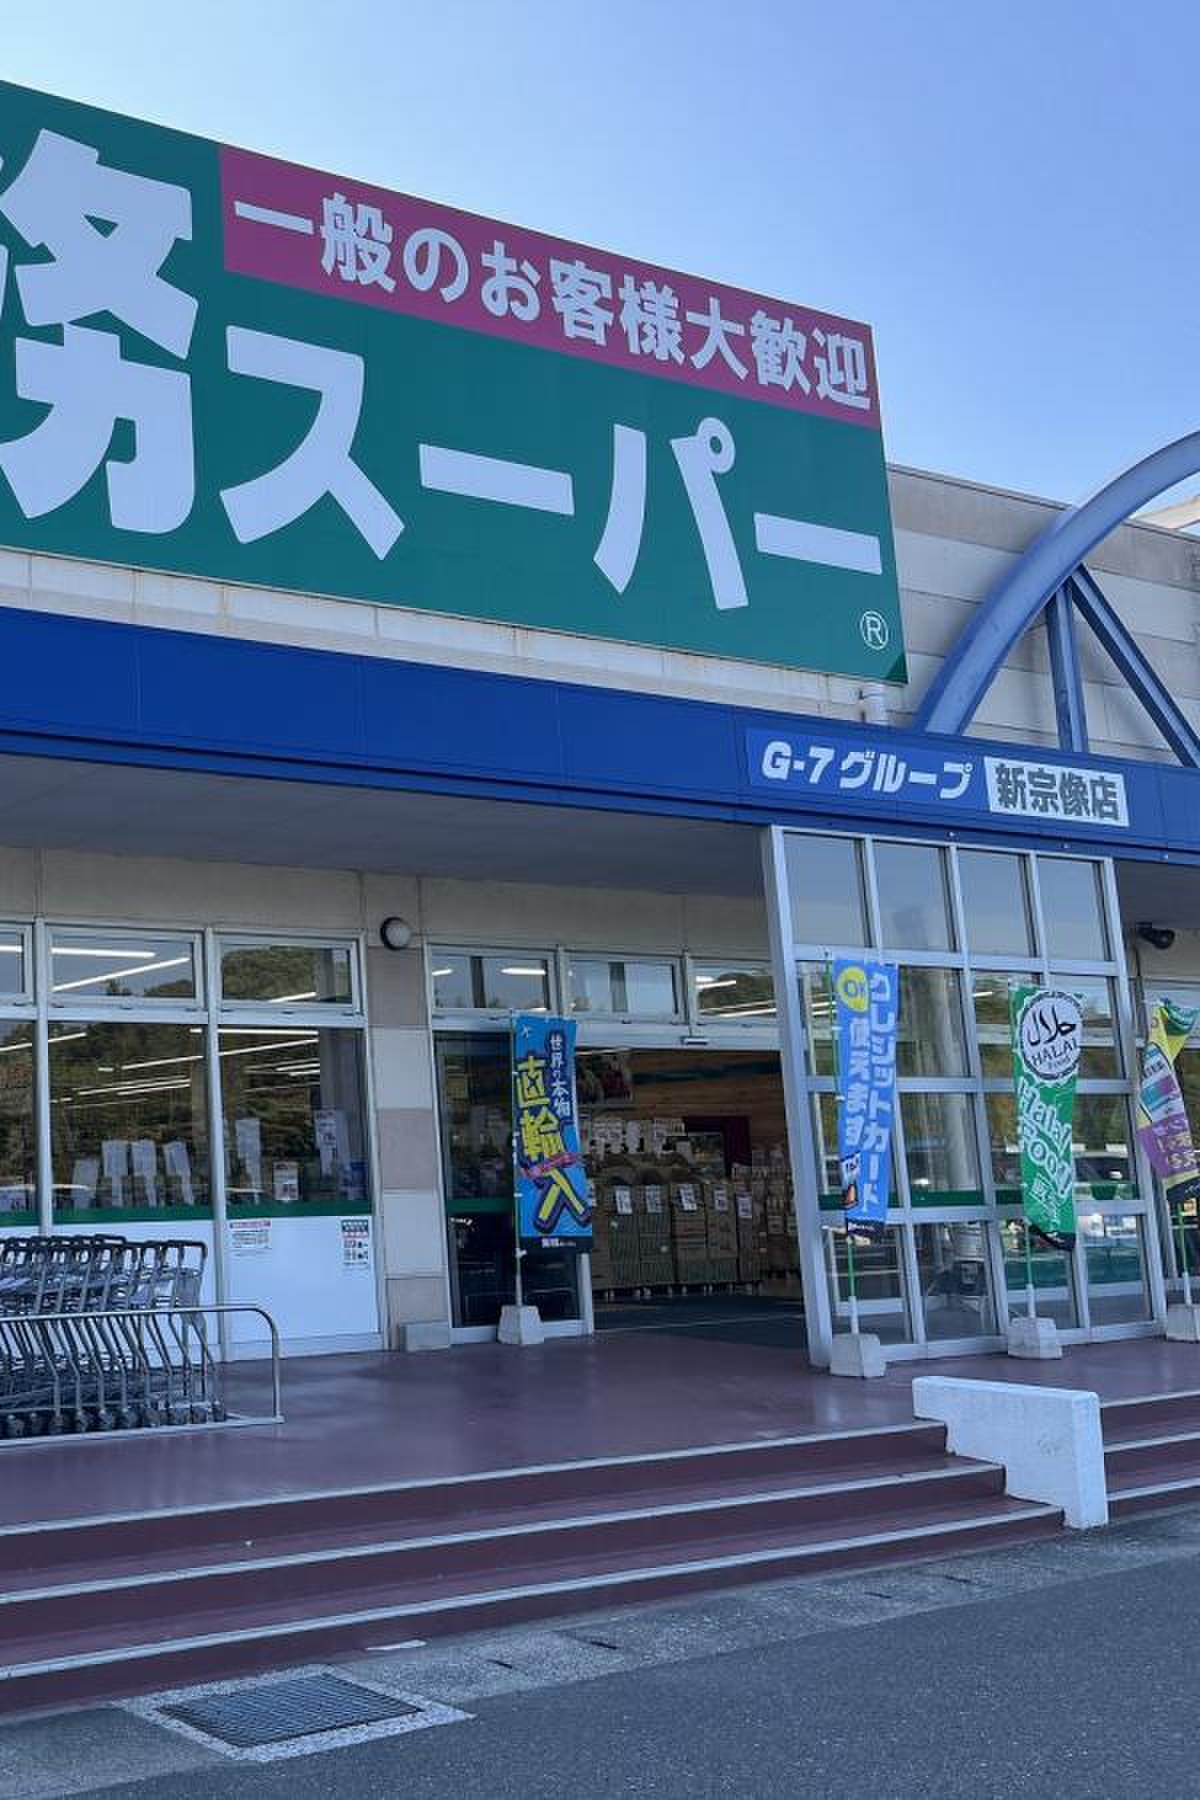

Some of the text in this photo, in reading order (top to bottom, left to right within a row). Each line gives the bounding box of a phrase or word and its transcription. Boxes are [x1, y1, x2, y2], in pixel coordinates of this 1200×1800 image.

[233, 191, 872, 411] 一般のお客様大歓迎
[995, 763, 1120, 822] 新宗像店
[517, 1054, 585, 1221] 直輸入
[862, 972, 896, 1213] クレジットカード
